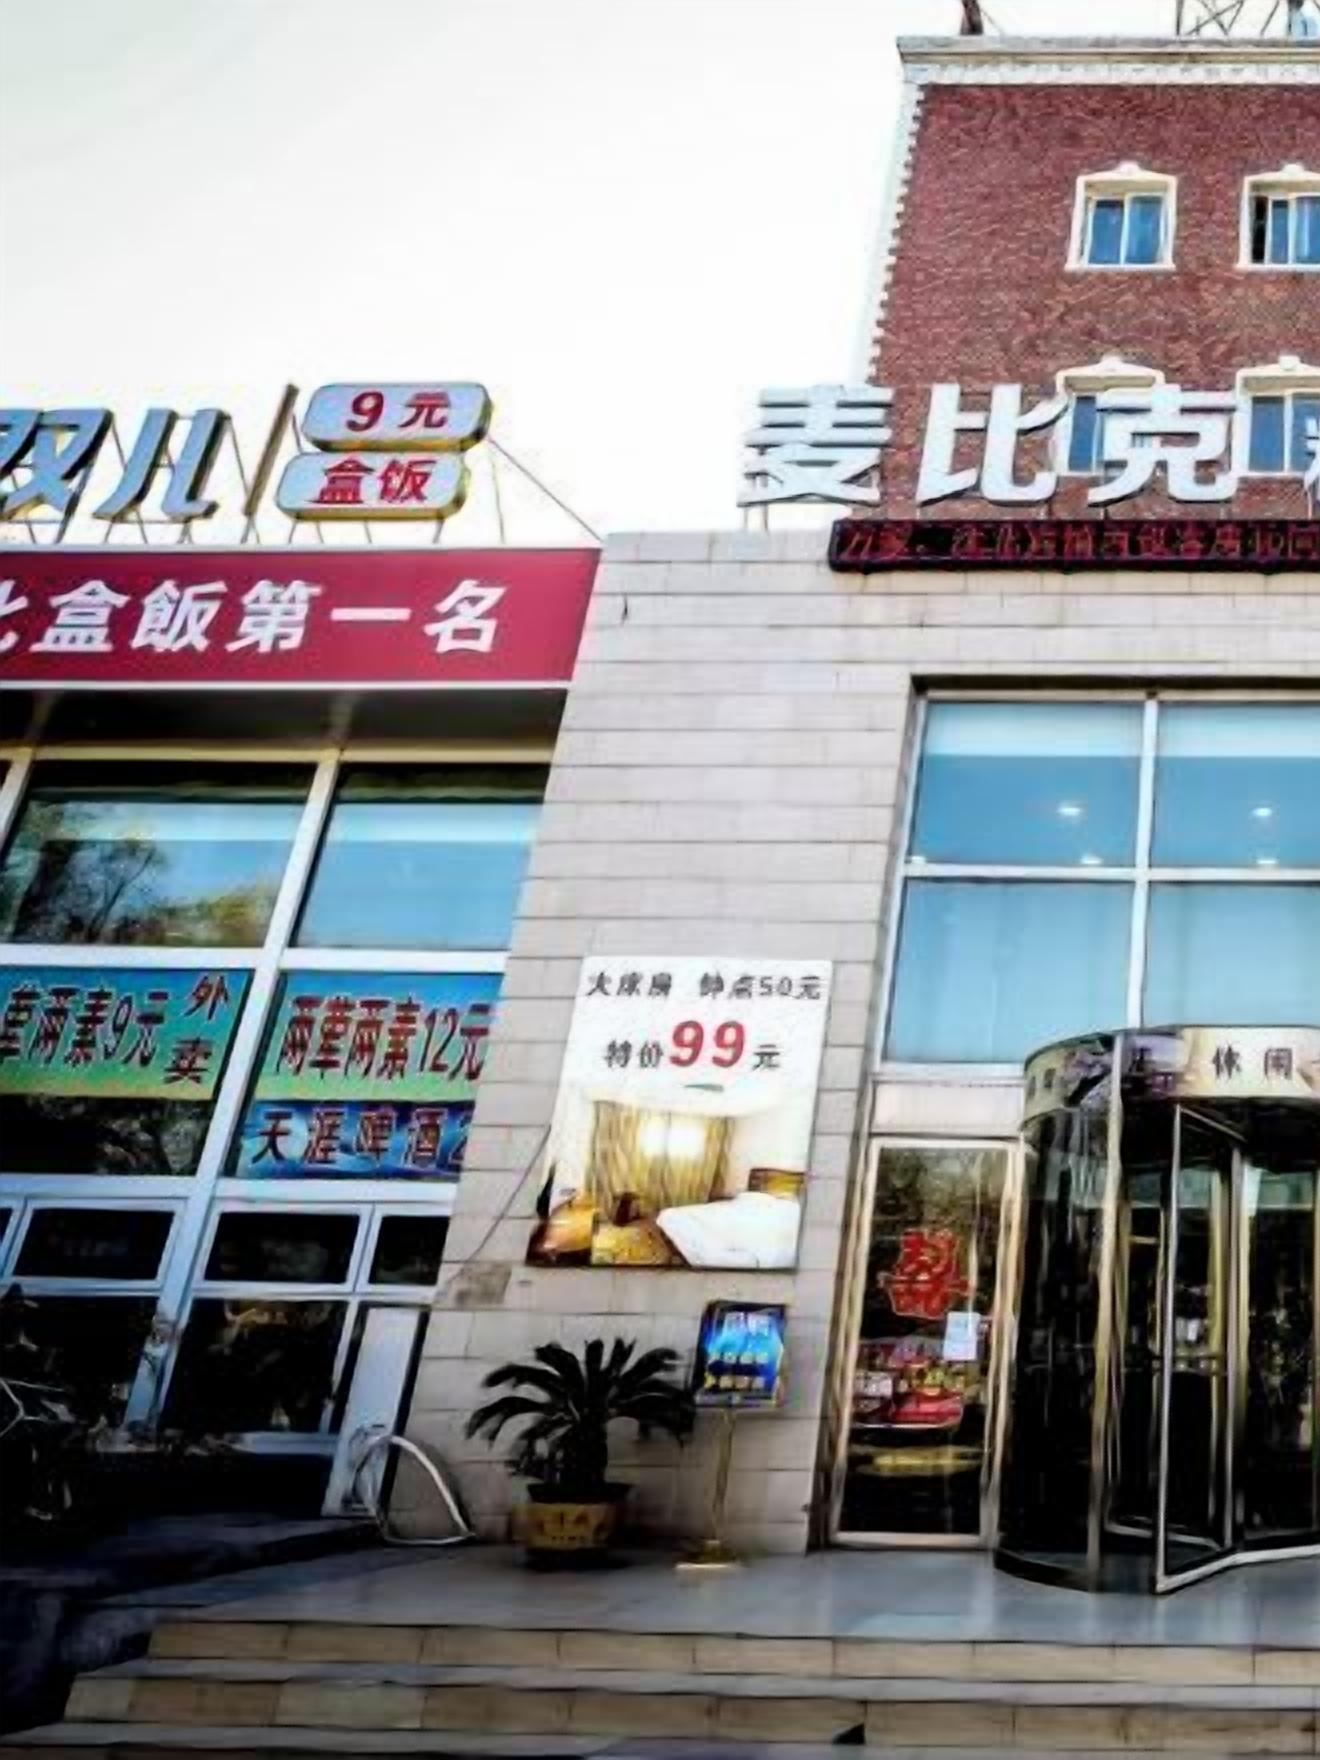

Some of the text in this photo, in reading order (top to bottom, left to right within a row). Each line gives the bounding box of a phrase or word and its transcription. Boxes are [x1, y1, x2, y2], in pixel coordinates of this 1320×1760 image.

[346, 390, 453, 432] 9元
[317, 459, 438, 505] 盒饭
[164, 975, 230, 1085] 外卖
[276, 995, 491, 1080] 两荤两素12元
